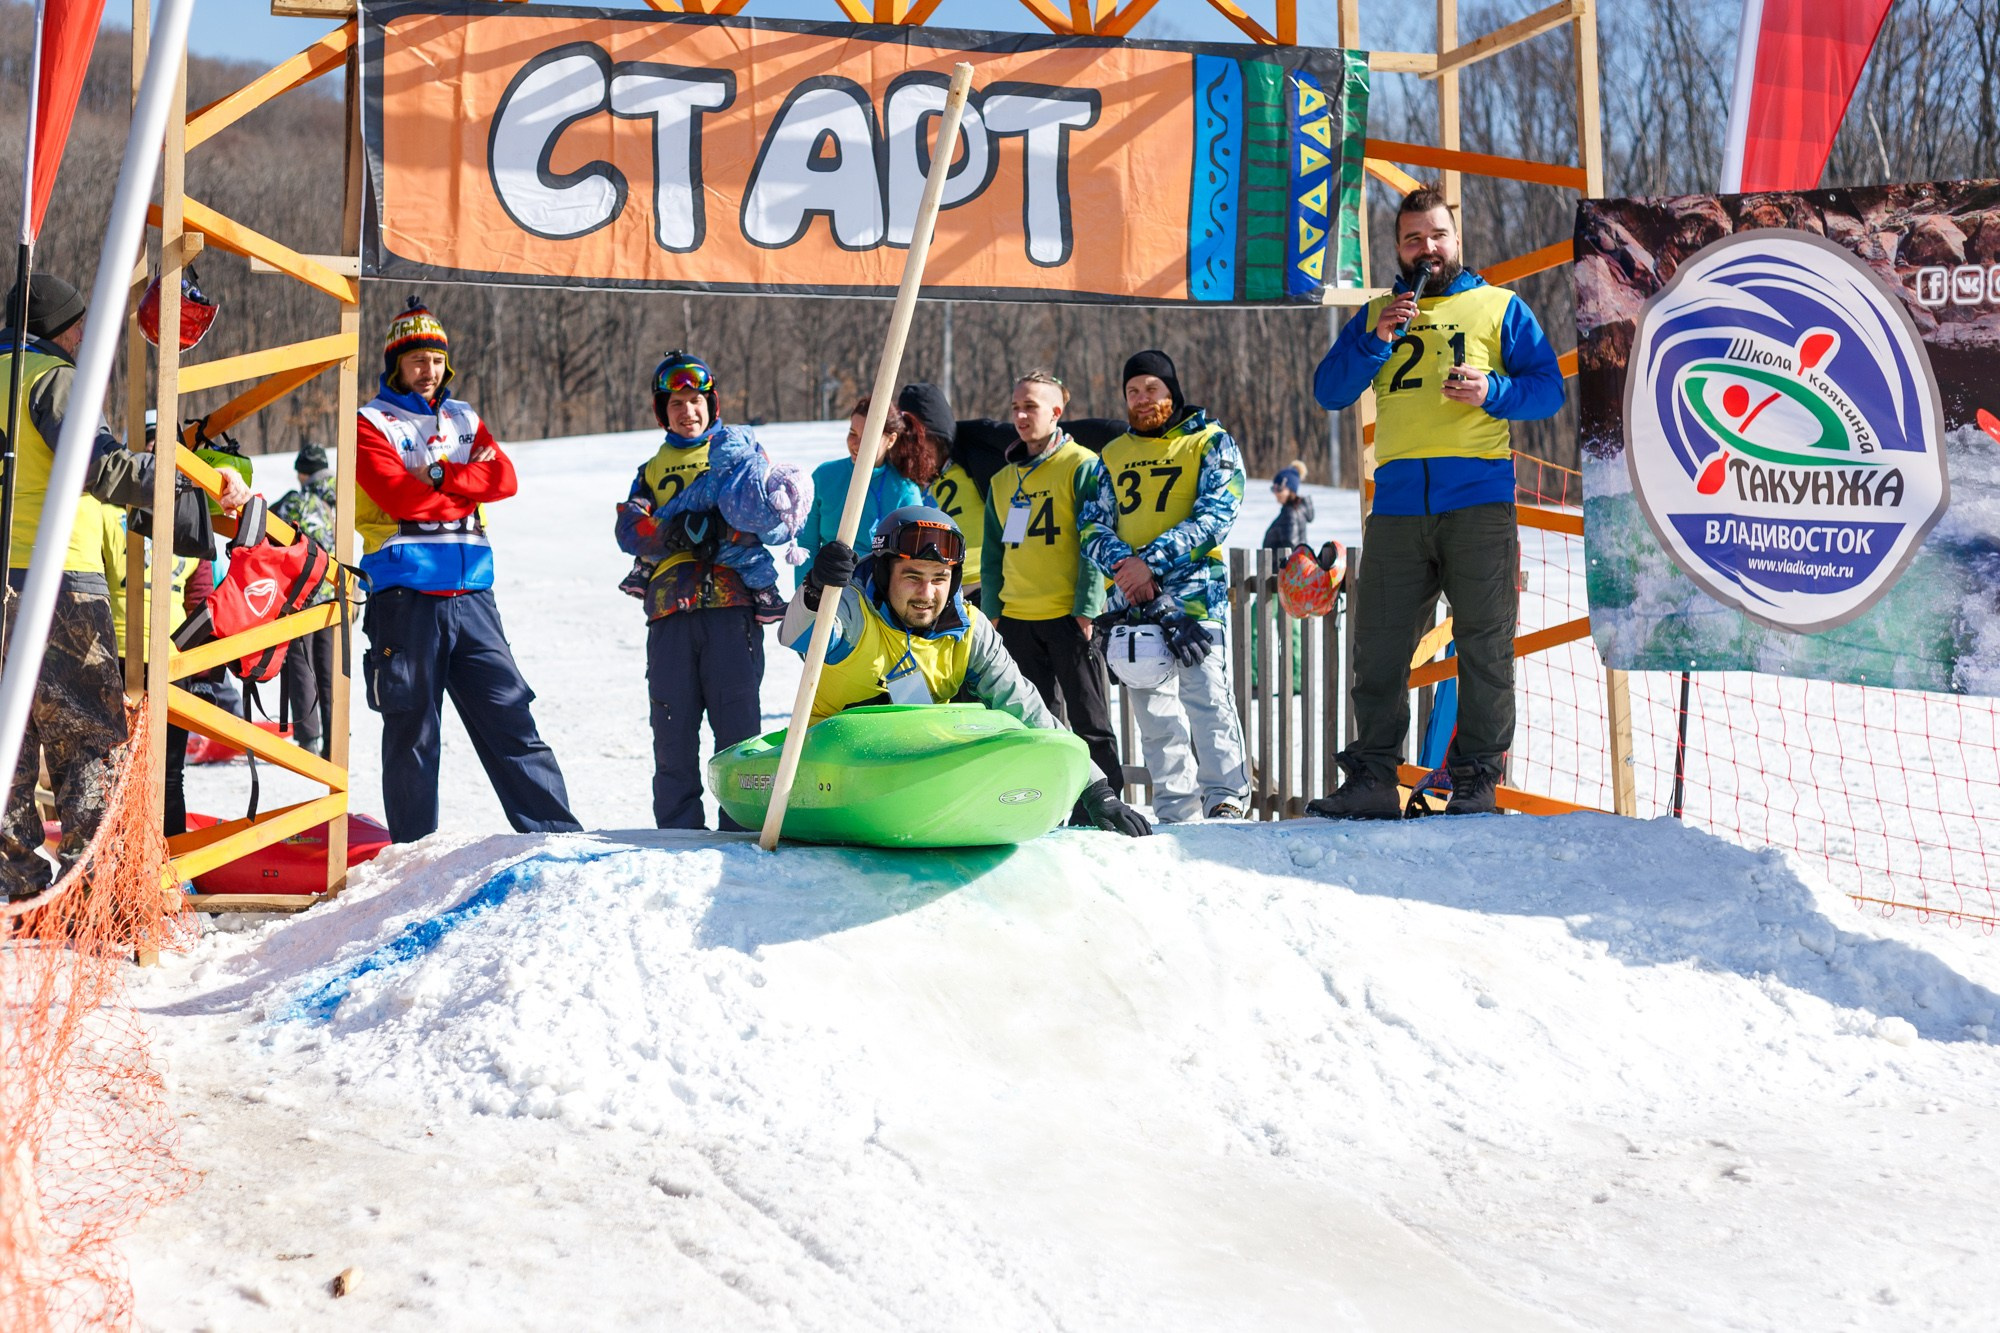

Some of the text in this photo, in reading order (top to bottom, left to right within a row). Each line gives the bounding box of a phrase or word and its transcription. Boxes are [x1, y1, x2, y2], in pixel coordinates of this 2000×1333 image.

[488, 42, 1101, 267] СТАРТ
[1728, 337, 1874, 455] Школа каякинга
[1117, 466, 1182, 516] 37
[1729, 458, 1905, 507] ТАКУНЖА
[1704, 519, 1875, 555] ВЛАДИВОСТОК
[1748, 556, 1855, 579] www.vladkayak.ru
